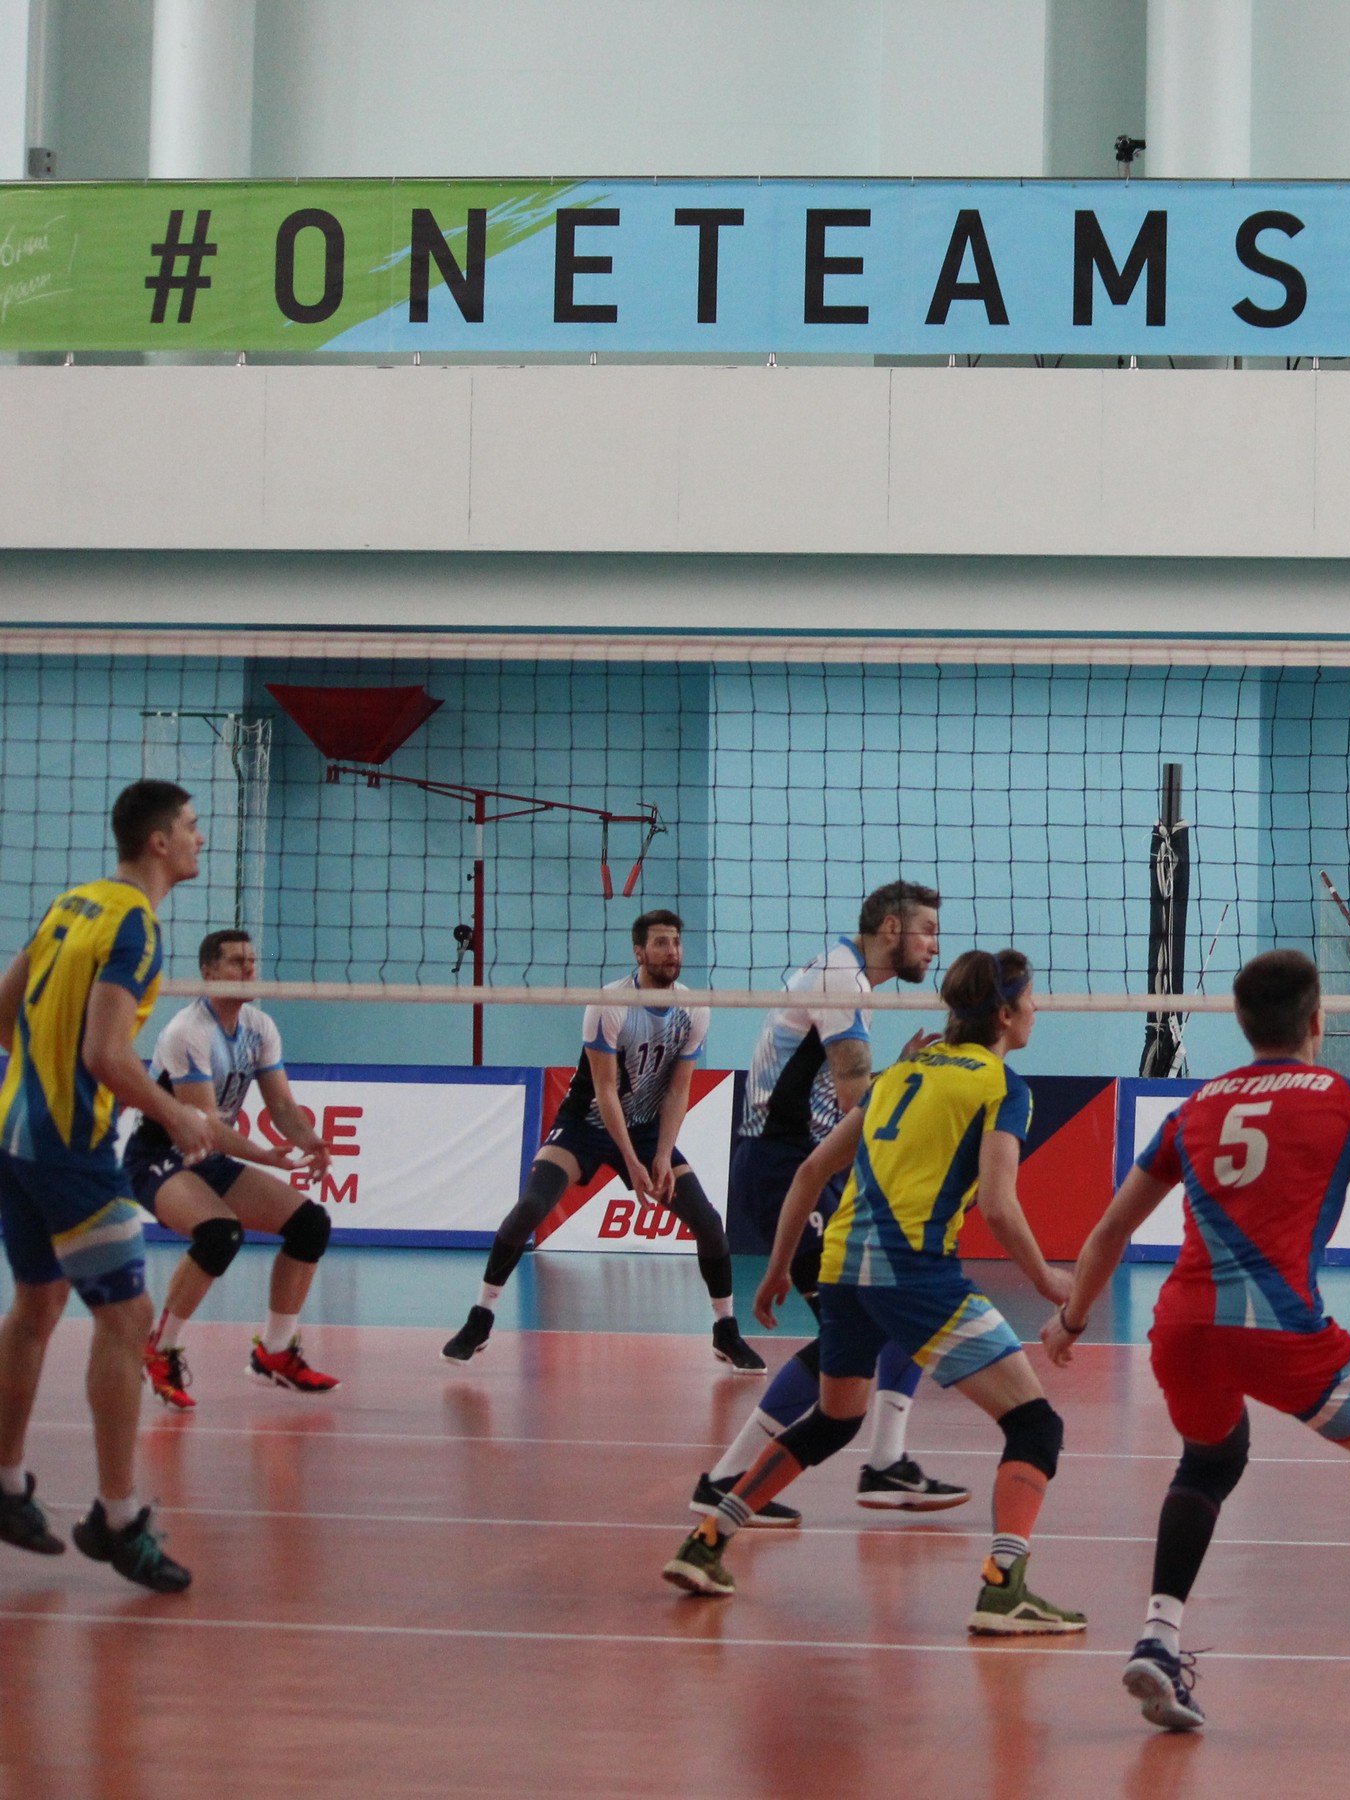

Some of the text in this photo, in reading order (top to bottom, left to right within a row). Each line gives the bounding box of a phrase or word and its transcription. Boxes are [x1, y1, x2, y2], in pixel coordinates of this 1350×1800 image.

[29, 924, 68, 1006] 7
[637, 1042, 666, 1076] 11
[873, 1073, 924, 1141] 1
[1213, 1100, 1273, 1188] 5
[809, 1211, 823, 1237] 9
